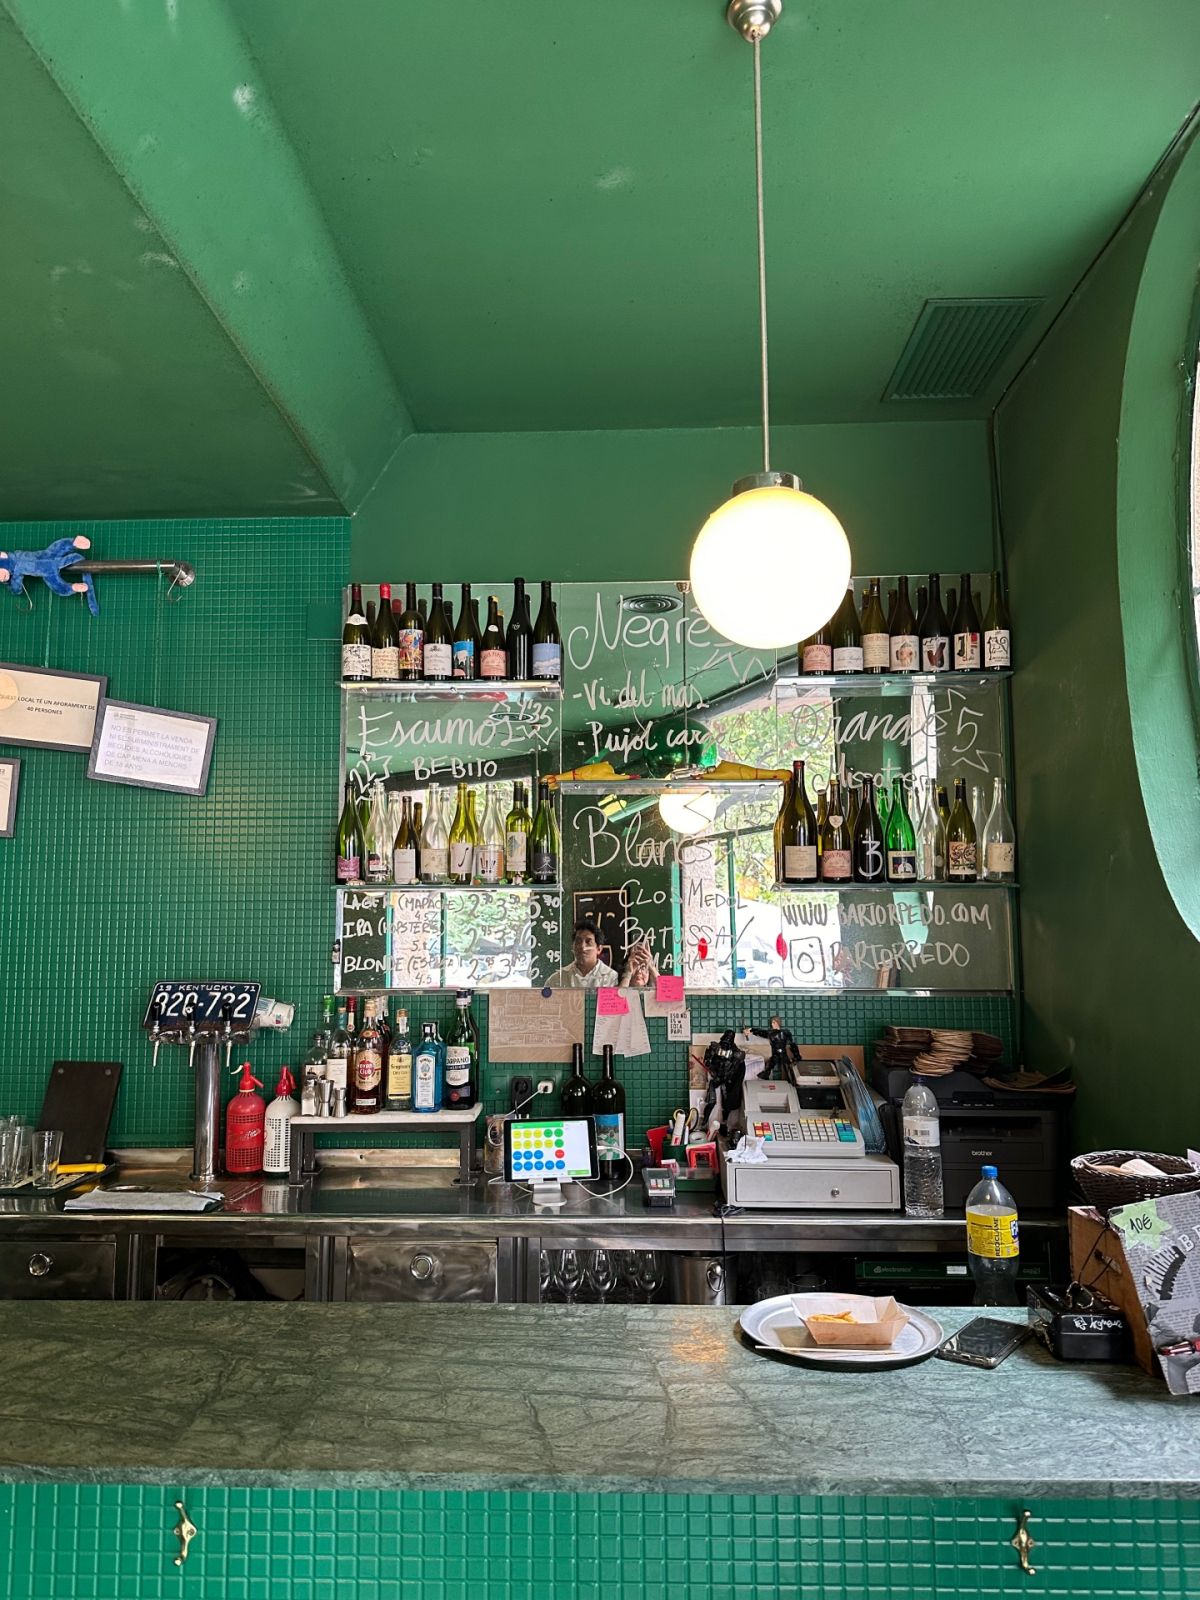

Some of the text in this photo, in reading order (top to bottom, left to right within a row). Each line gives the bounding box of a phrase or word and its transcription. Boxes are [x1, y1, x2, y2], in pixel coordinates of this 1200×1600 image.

[615, 669, 652, 709] del
[661, 683, 710, 709] mas
[34, 707, 63, 715] PERSONES
[53, 700, 88, 709] AFORAMENT
[111, 724, 121, 732] NO
[132, 728, 160, 738] PERMET
[171, 735, 193, 744] VENDA
[158, 759, 188, 770] MENORS
[412, 755, 497, 781] BEBITO
[573, 806, 712, 868] Blancs
[1129, 1213, 1153, 1234] 10€
